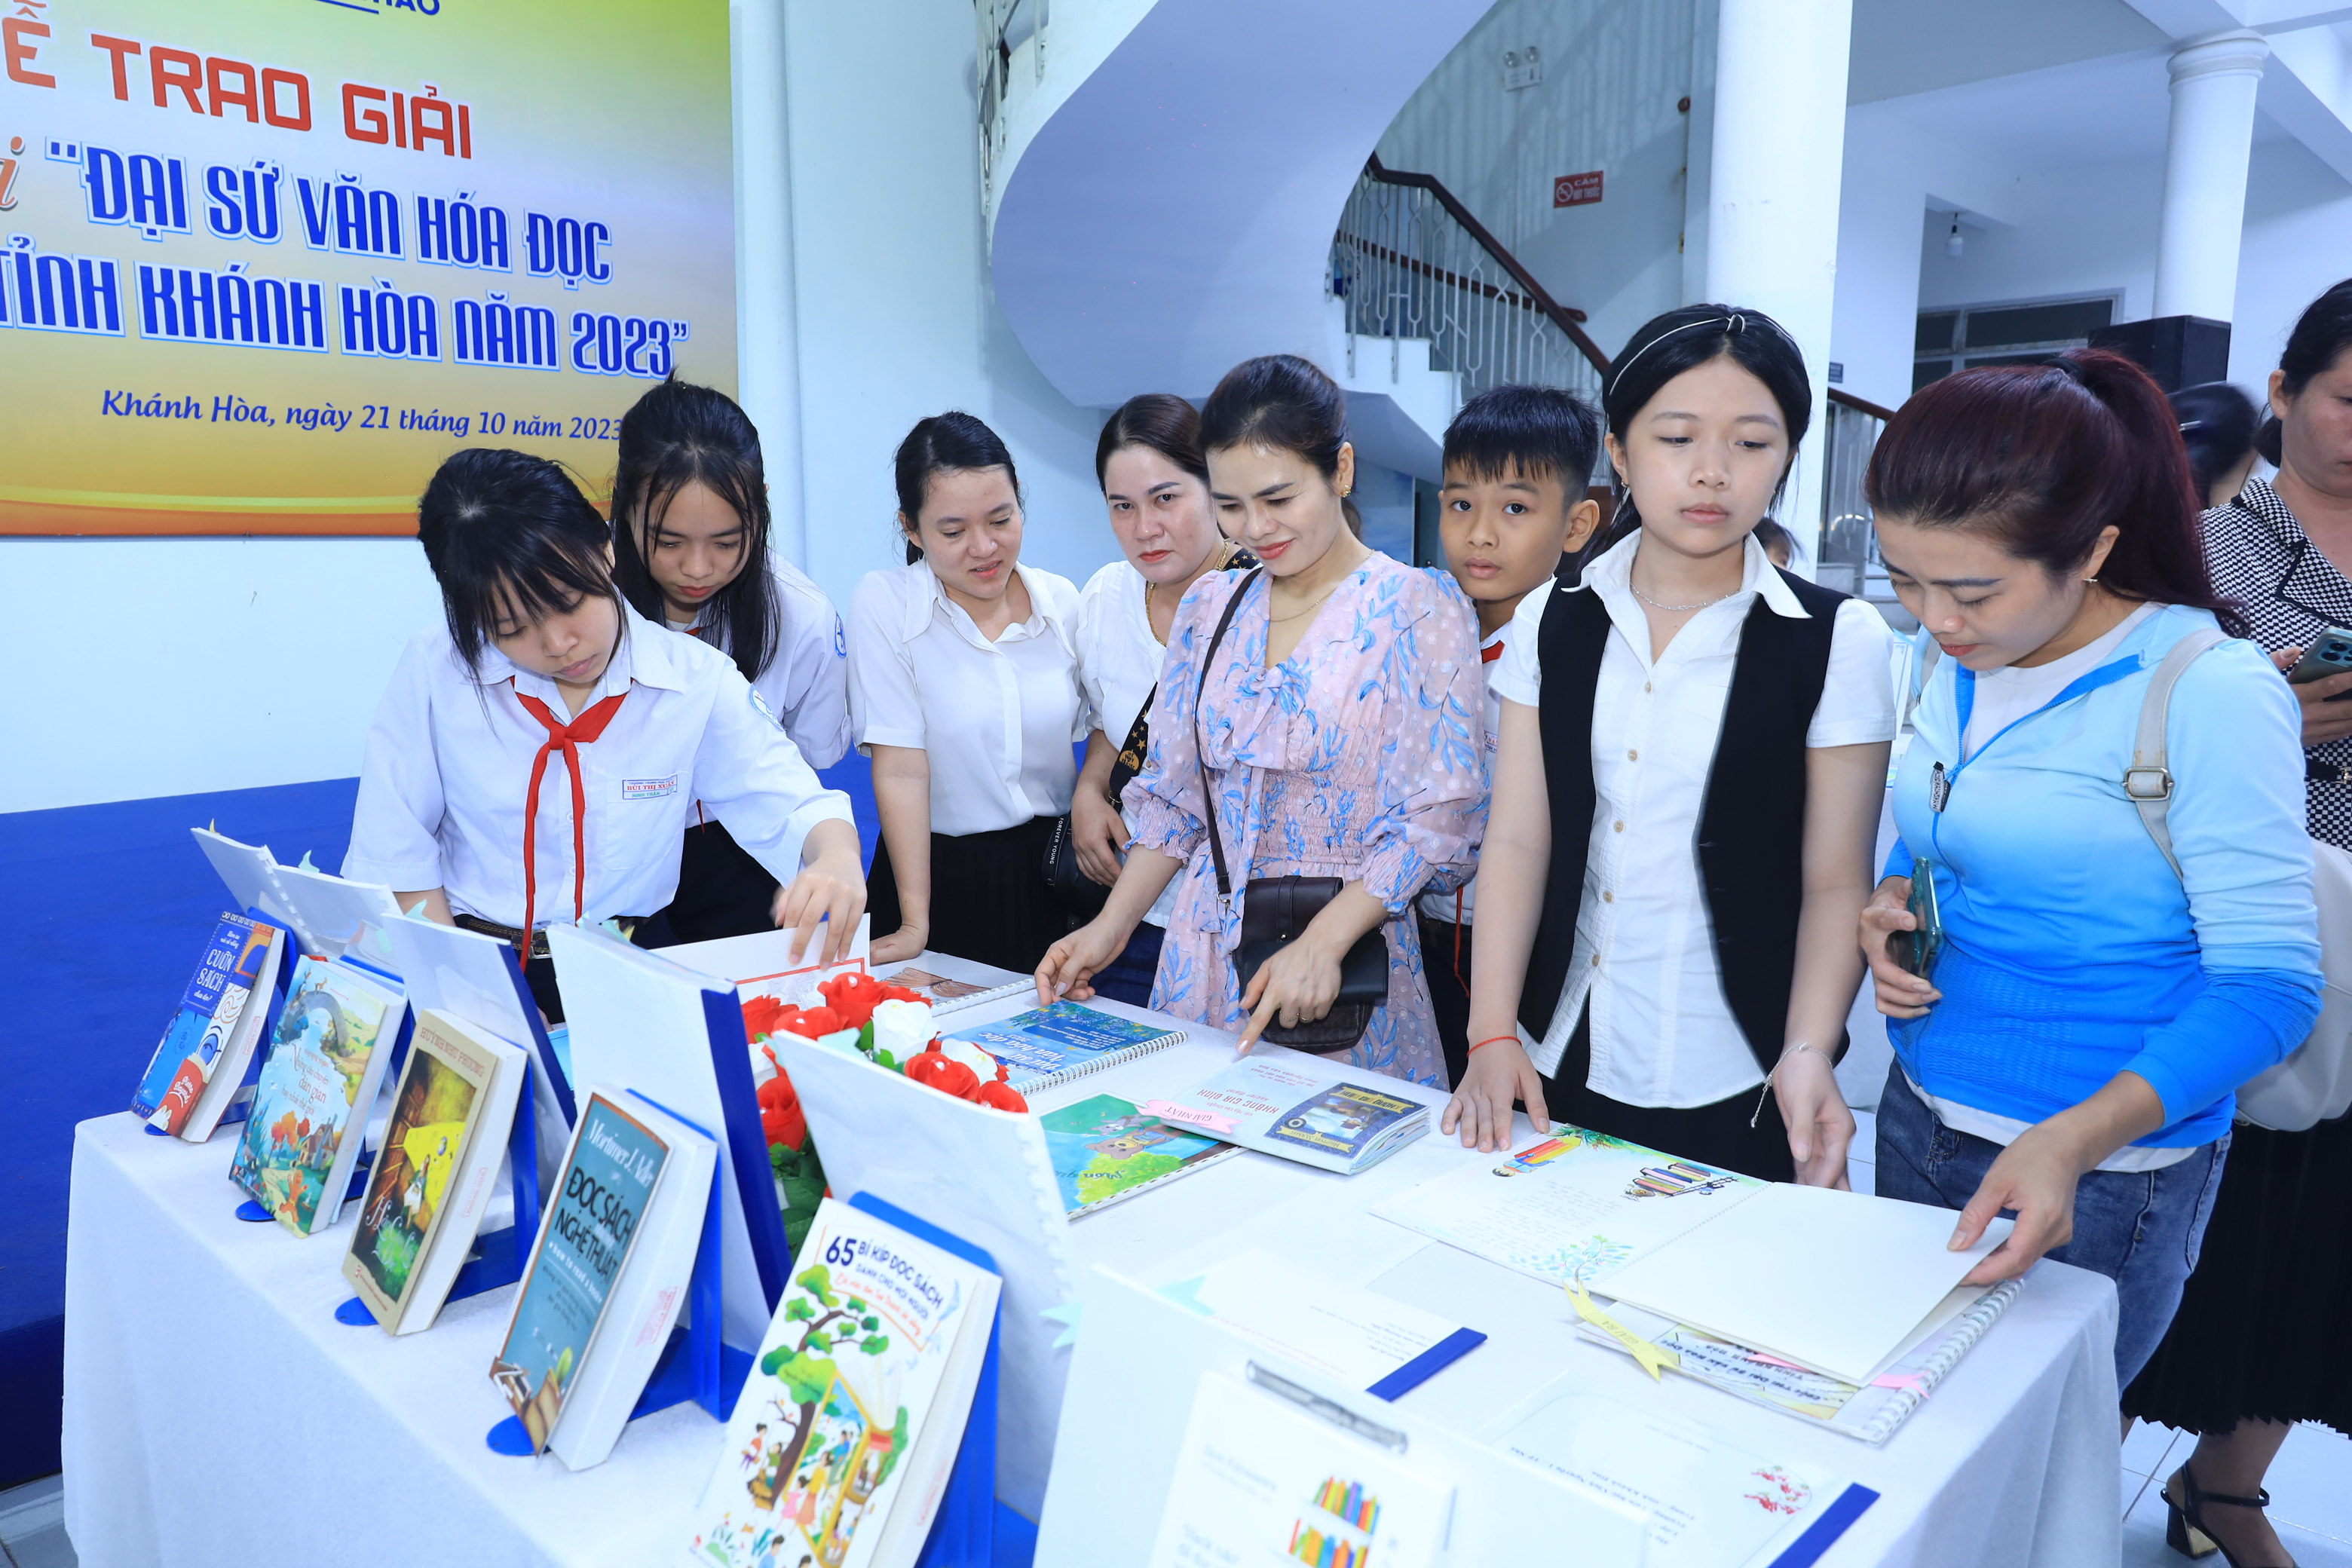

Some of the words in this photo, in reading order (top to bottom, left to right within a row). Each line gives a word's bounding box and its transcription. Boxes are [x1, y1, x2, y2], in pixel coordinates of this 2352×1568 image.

[90, 33, 312, 131] TRAO
[342, 85, 472, 159] GIẢI
[208, 161, 280, 239] SỨ
[296, 174, 402, 255] VĂN
[417, 192, 509, 268] HÓA
[526, 213, 610, 286] ĐỌC
[139, 265, 325, 348] KHÁNH
[341, 280, 438, 358] HÒA
[455, 293, 557, 367] NĂM
[102, 390, 203, 420] Khánh
[211, 394, 276, 427] Hòa,
[286, 403, 353, 432] ngày
[360, 405, 390, 429] 21
[399, 409, 471, 437] tháng
[478, 412, 506, 434] 10
[513, 415, 563, 437] năm
[569, 417, 623, 440] 2023
[657, 780, 675, 789] XUÂN
[196, 968, 227, 992] SÁCH
[1197, 1089, 1223, 1100] ĐÌNH
[1223, 1095, 1243, 1104] GIA
[1243, 1100, 1281, 1114] KHÔNG
[1165, 1106, 1194, 1119] NHẤT
[1194, 1114, 1213, 1122] GIẢI
[584, 1118, 631, 1165] Mortimer
[629, 1154, 654, 1188] Adler
[566, 1166, 606, 1217] ĐỌC
[598, 1195, 637, 1251] SÁCH
[552, 1241, 565, 1262] how
[565, 1255, 574, 1269] to
[555, 1207, 591, 1259] NGHỆ
[585, 1234, 618, 1285] THUẬT
[825, 1236, 857, 1266] 65
[858, 1239, 874, 1256] BÍ
[890, 1255, 914, 1282] ĐỌC
[913, 1274, 944, 1309] SÁCH
[877, 1273, 895, 1290] CHO
